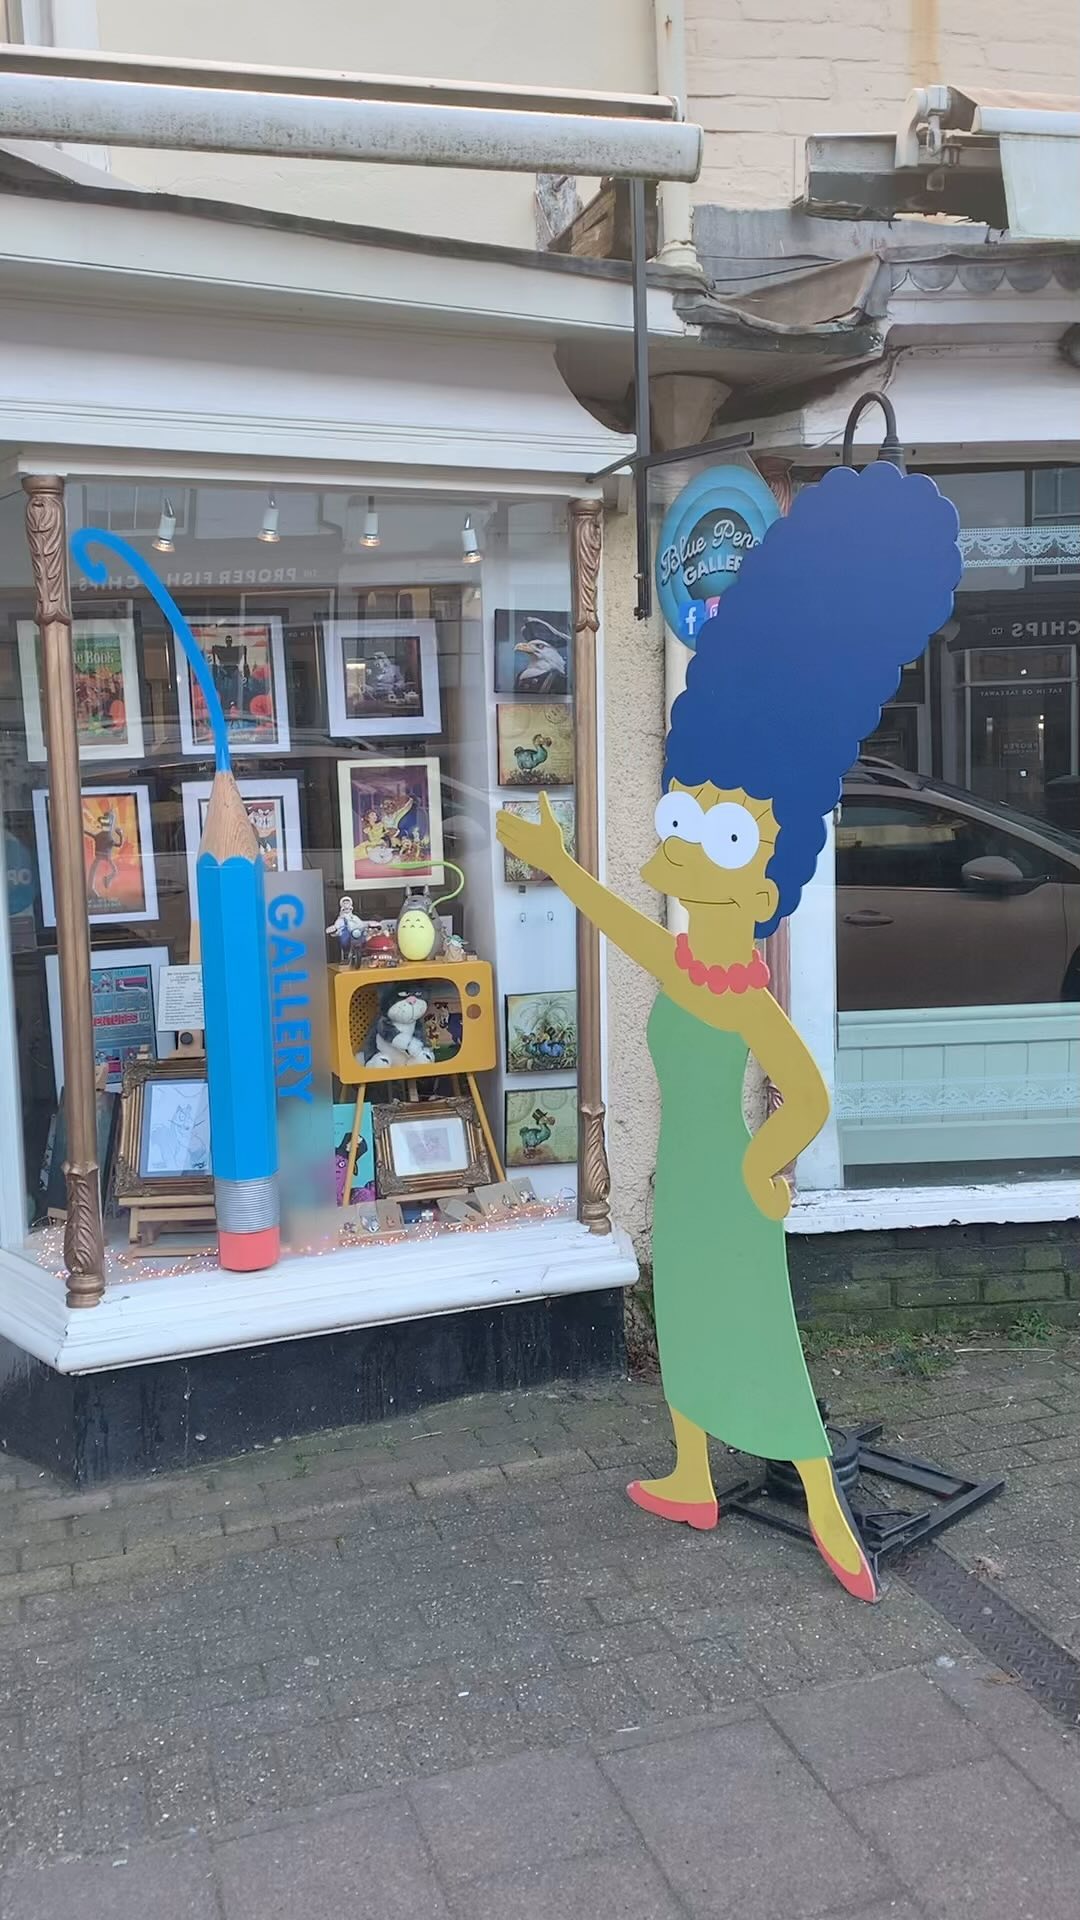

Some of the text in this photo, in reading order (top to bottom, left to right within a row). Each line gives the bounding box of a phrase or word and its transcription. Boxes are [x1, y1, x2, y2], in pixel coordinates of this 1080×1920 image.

[661, 519, 762, 583] Blue Pen
[84, 650, 114, 664] Book
[268, 893, 313, 1105] GALLERY
